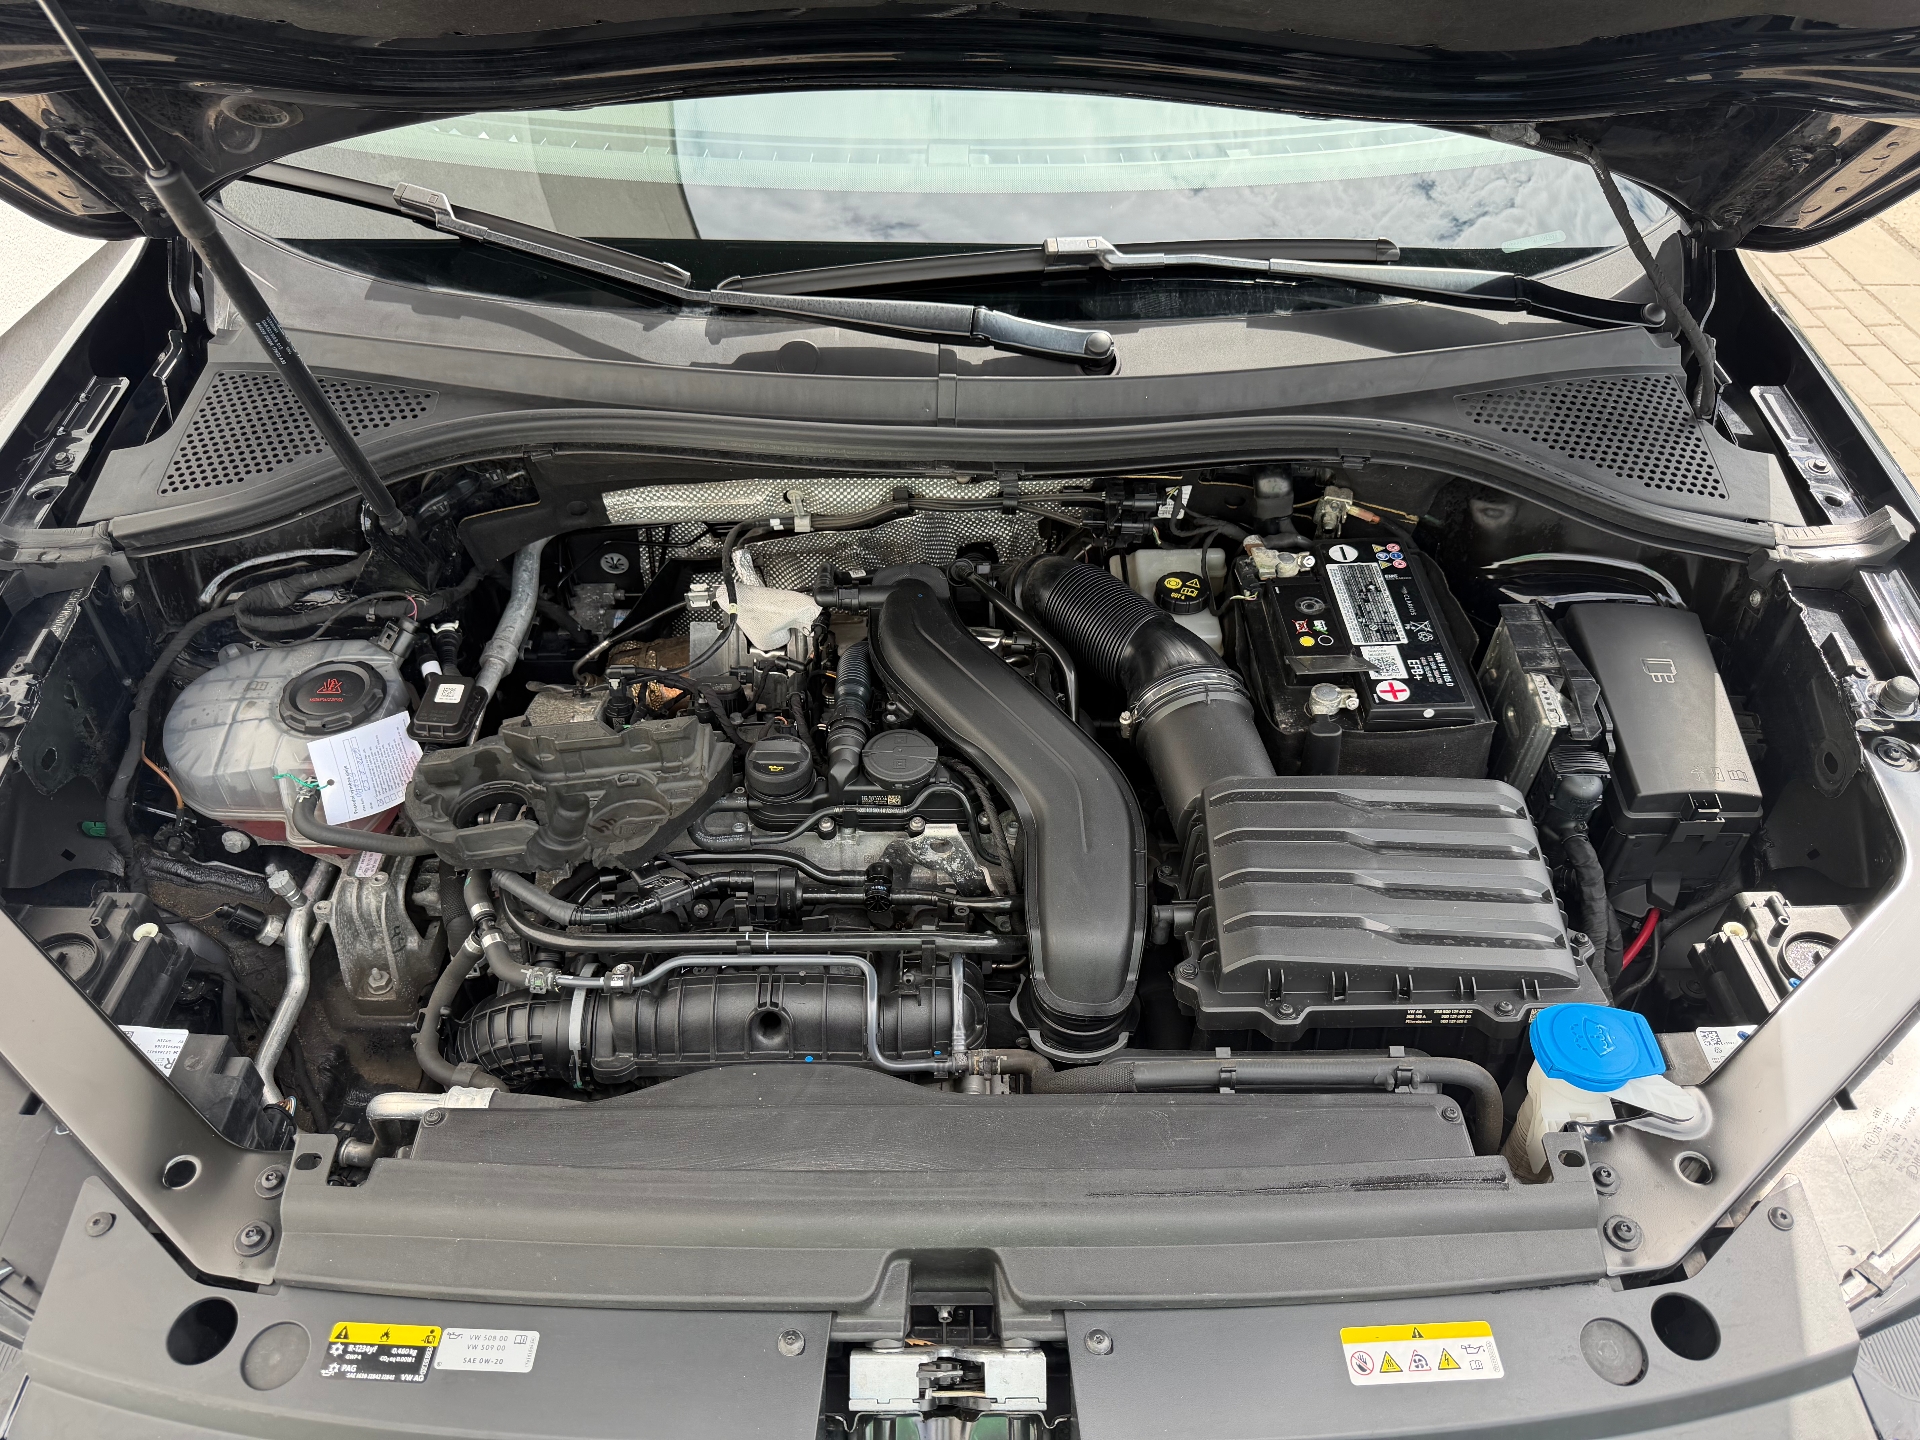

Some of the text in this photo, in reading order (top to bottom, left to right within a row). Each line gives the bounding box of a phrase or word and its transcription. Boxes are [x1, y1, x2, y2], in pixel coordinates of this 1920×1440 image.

[1404, 594, 1416, 616] CLARIOS
[1407, 660, 1424, 680] EFB+
[348, 1344, 378, 1355] R-1234yf
